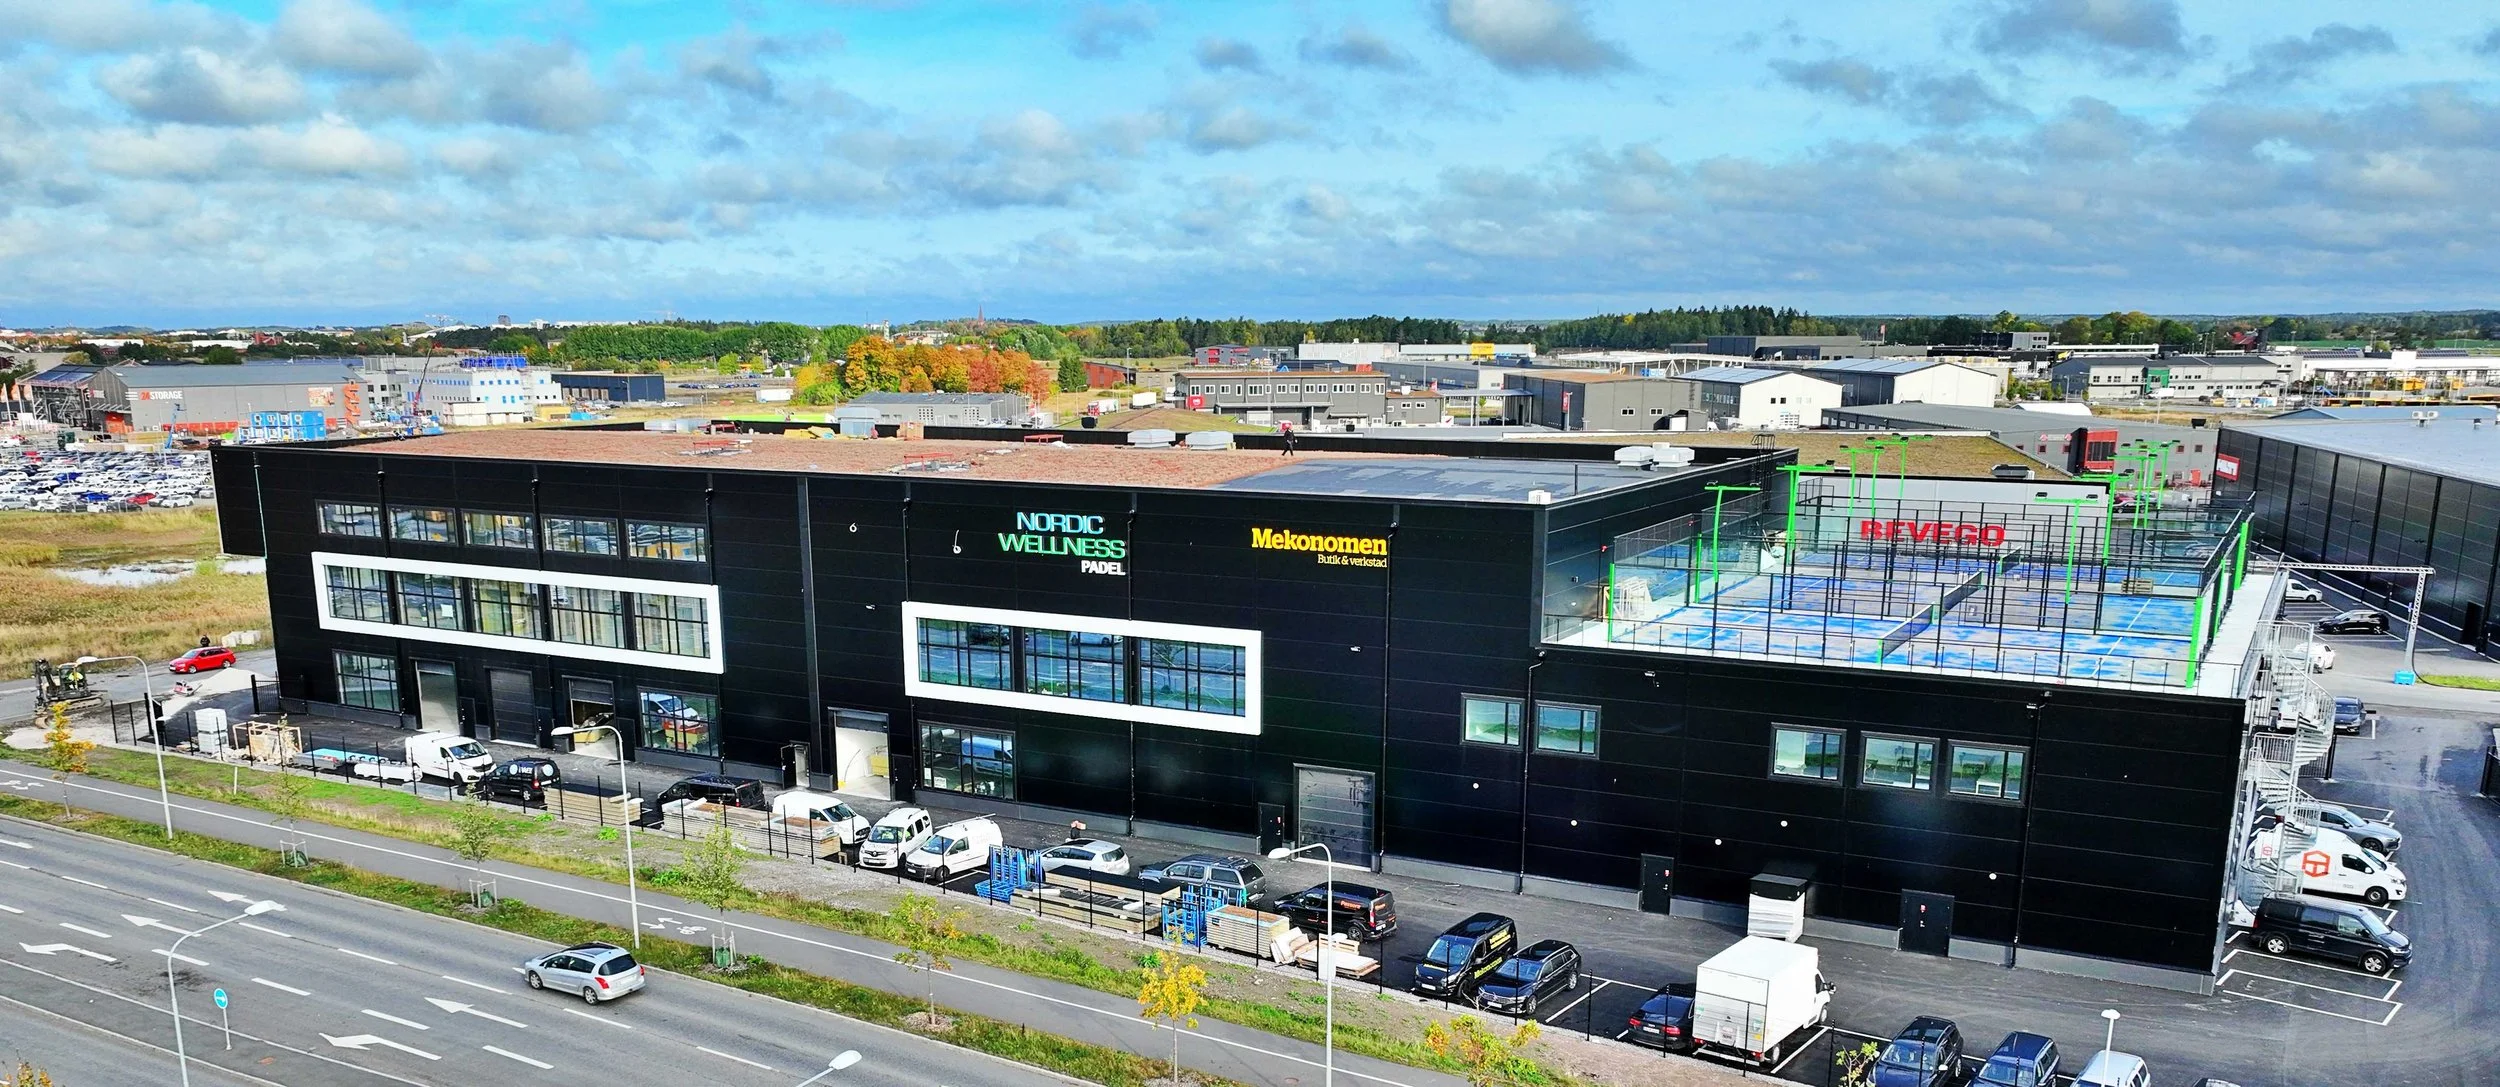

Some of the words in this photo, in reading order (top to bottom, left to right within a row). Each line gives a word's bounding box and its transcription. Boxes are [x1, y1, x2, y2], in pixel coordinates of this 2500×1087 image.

[1016, 511, 1104, 534] NORDIC
[1860, 520, 2006, 547] BEVEGO
[998, 532, 1126, 559] WELLNESS
[1251, 528, 1388, 555] Mekonomen
[1081, 560, 1126, 575] PADEL
[1317, 553, 1341, 565] Butik
[1341, 555, 1349, 565] &
[1349, 556, 1387, 568] verkstad
